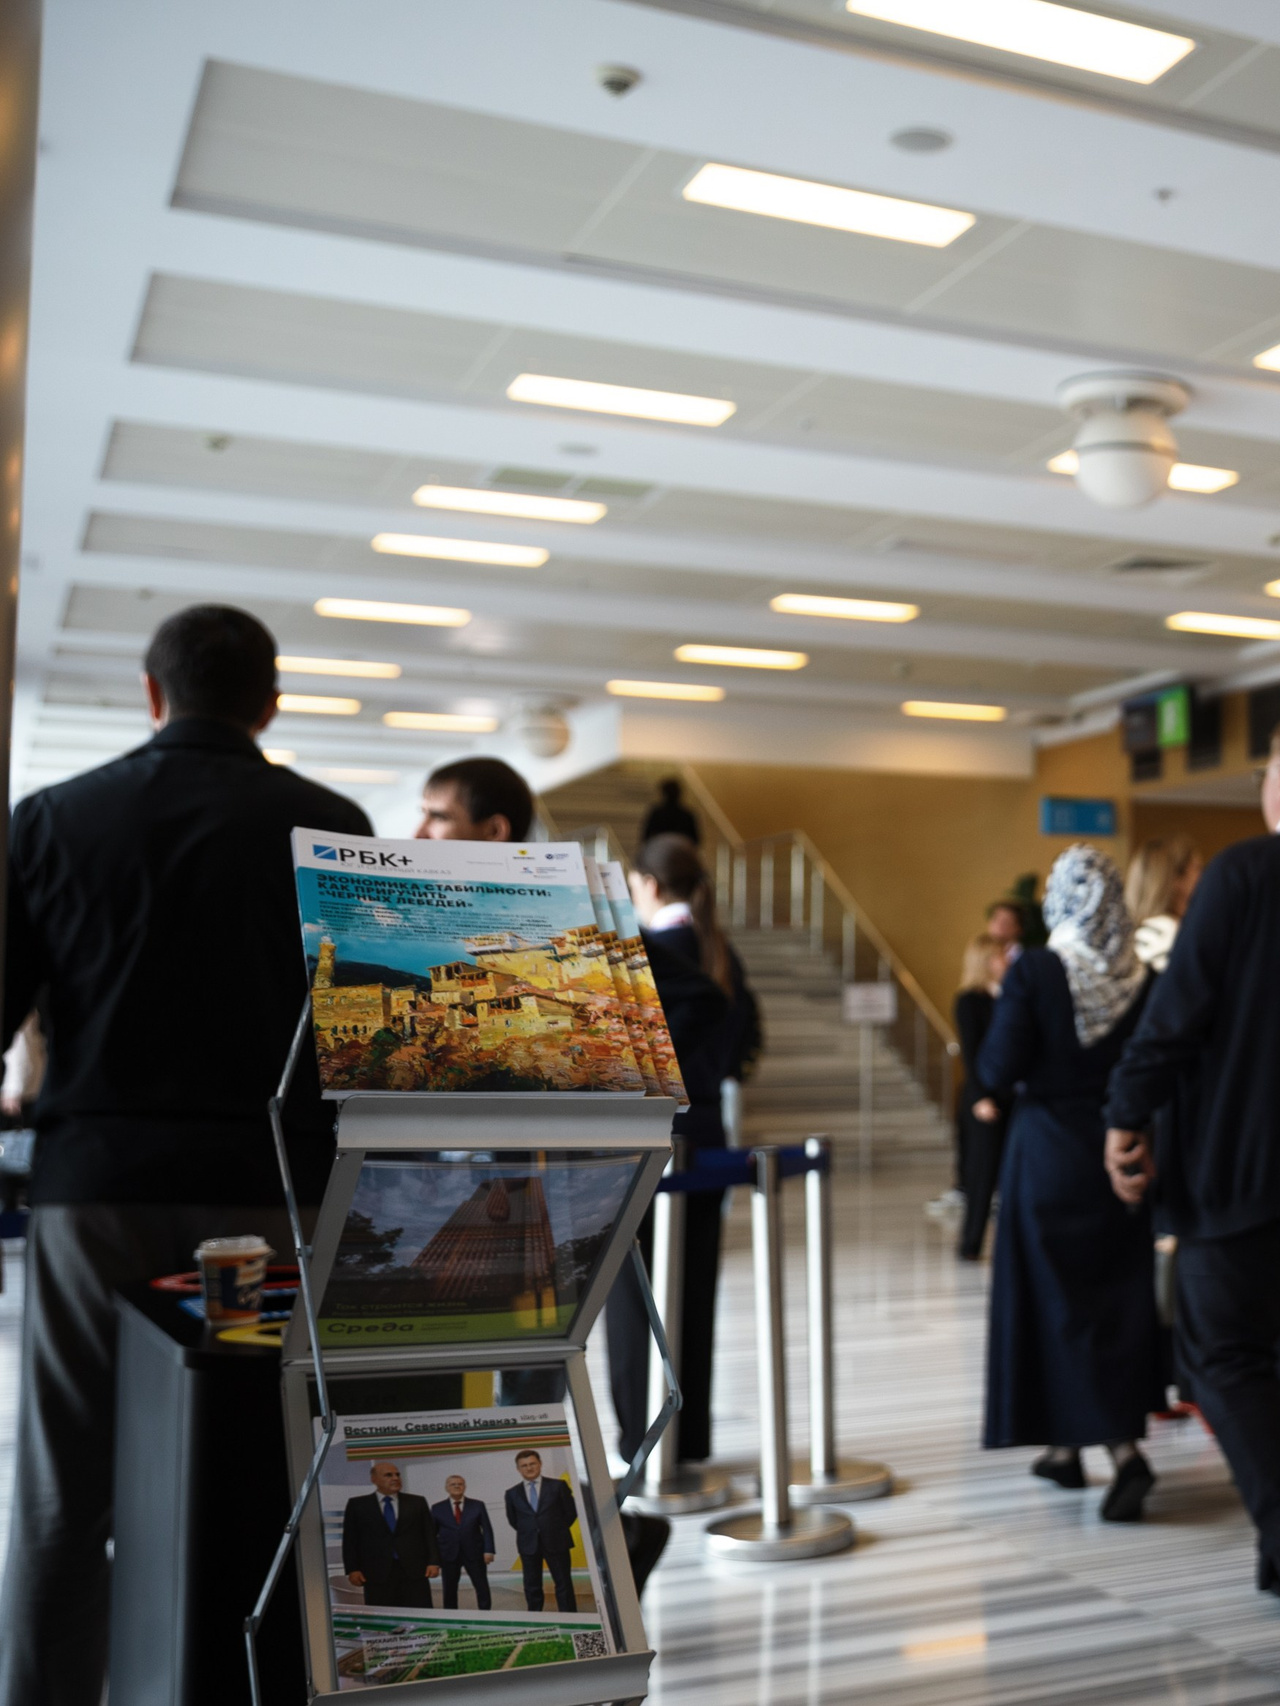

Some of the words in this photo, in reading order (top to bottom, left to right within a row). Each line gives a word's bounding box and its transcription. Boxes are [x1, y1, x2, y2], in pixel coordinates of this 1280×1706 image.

[339, 847, 413, 869] РБК+
[316, 873, 421, 891] ЭКОНОМИКА
[424, 883, 552, 897] СТАБИЛЬНОСТИ:
[318, 882, 350, 892] КАК
[354, 884, 447, 901] ПРИРУЧИТЬ
[318, 889, 393, 904] «ЧЕРНЫХ
[396, 895, 474, 910] ЛЕБЕДЕЙ»
[327, 1322, 415, 1337] Среда
[405, 1419, 470, 1433] Северный
[473, 1417, 518, 1428] Кавказ
